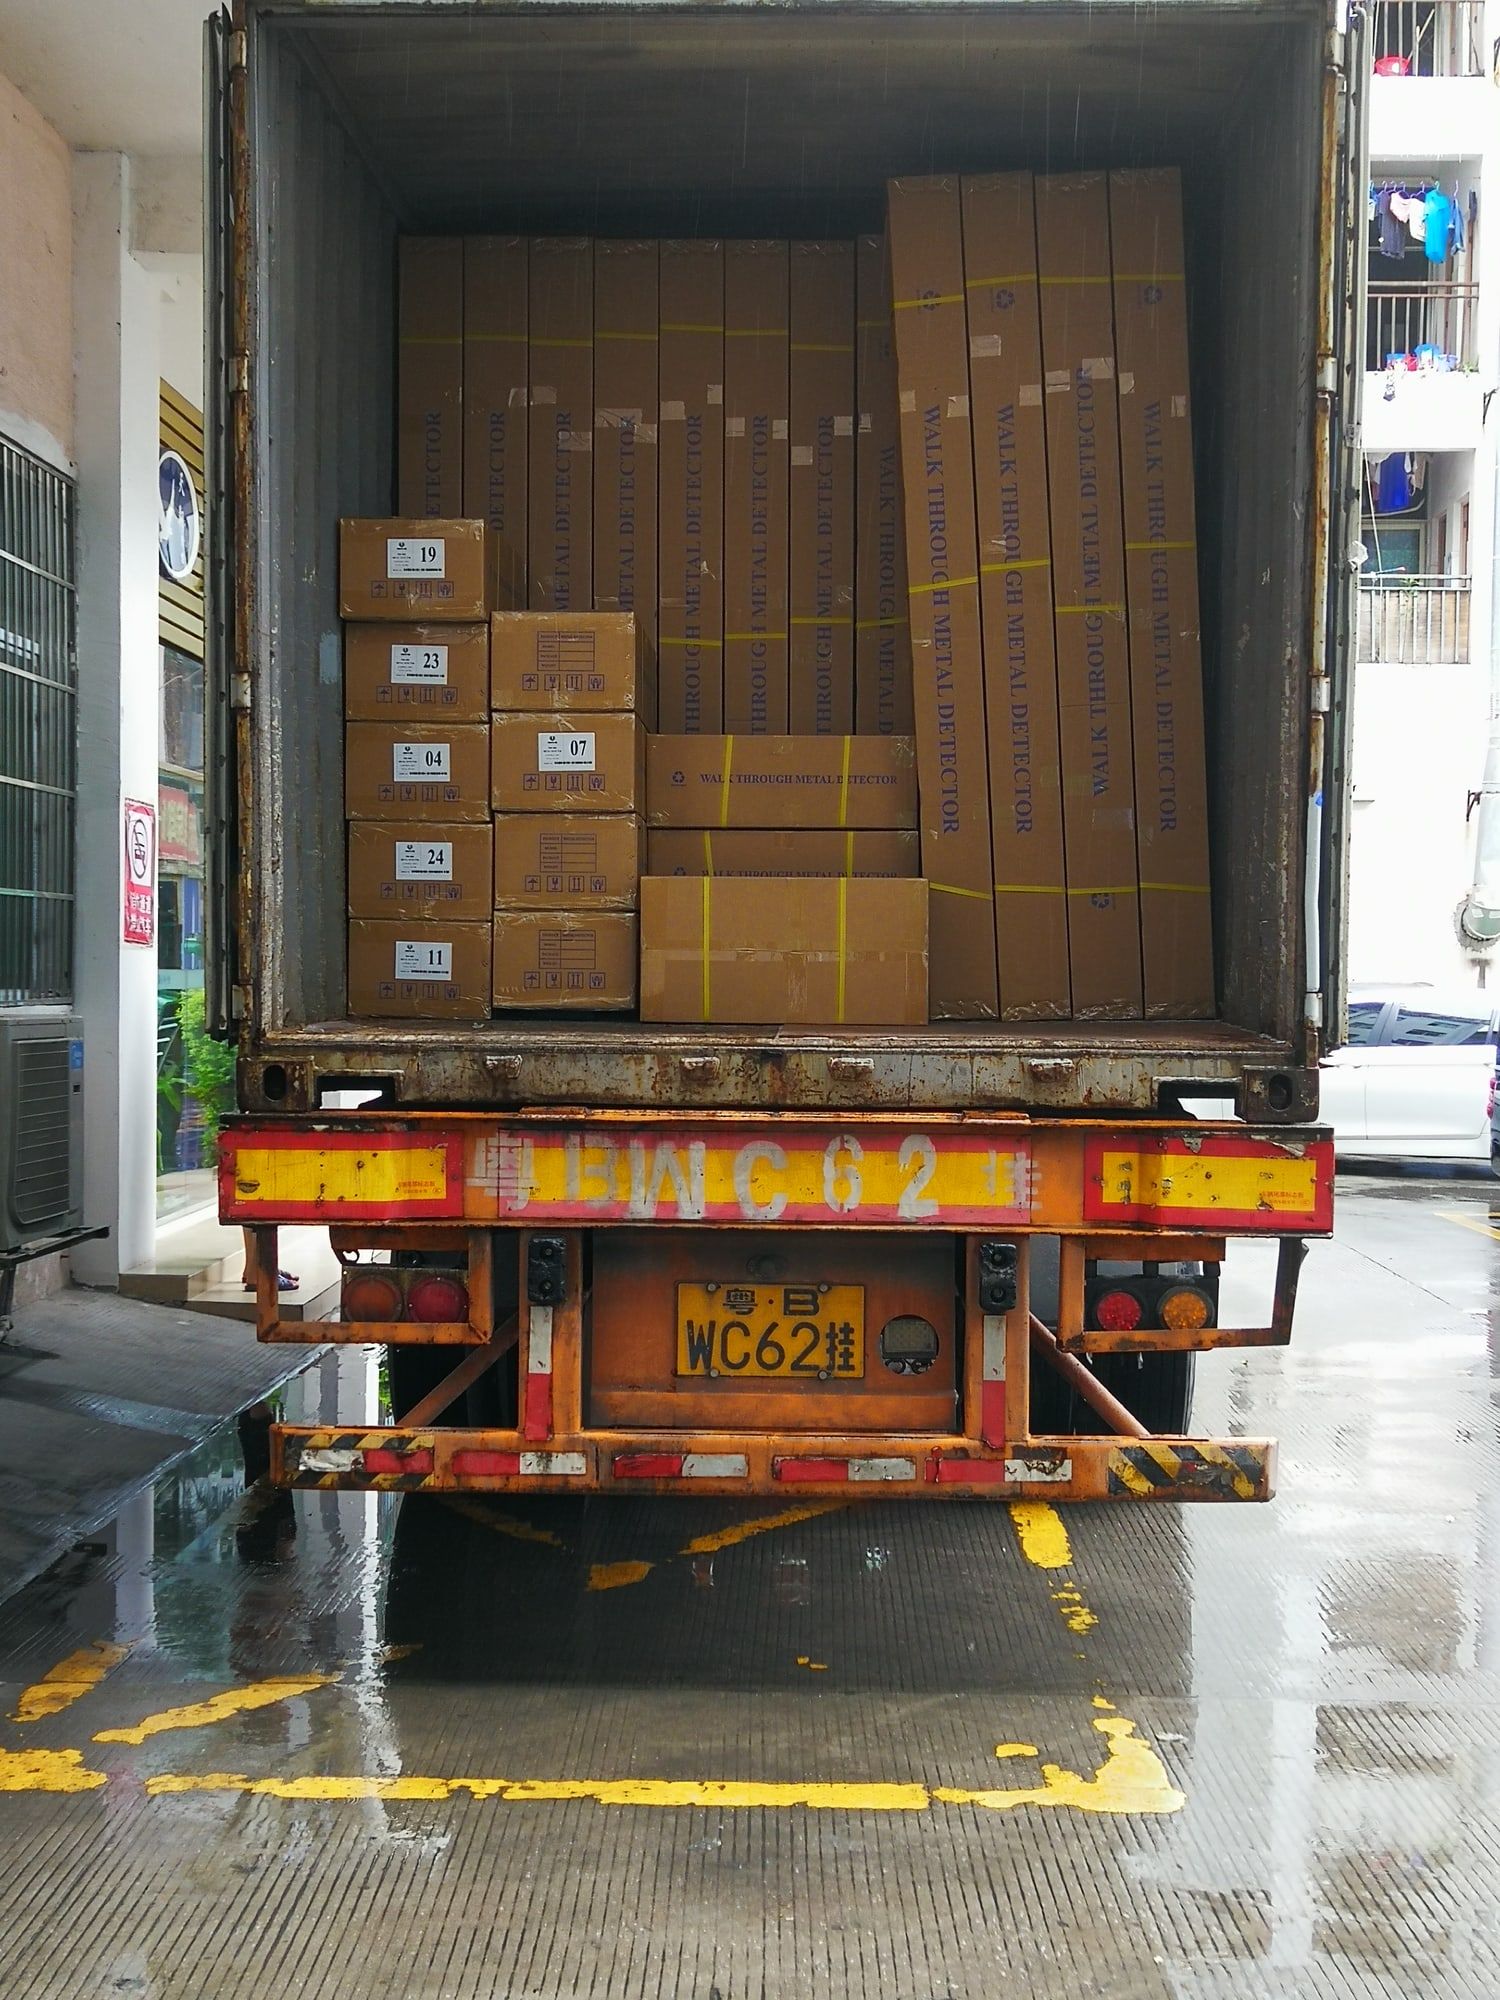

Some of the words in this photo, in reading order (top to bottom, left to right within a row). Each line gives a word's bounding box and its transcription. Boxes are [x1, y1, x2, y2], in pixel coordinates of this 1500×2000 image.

[426, 411, 441, 516] ETECTOR
[923, 404, 944, 478] WALK
[998, 404, 1017, 477] WALK
[1076, 367, 1098, 498] DETECTOR
[1143, 401, 1163, 473] WALK
[555, 411, 571, 533] DETECTOR
[619, 415, 635, 536] DETECTOR
[686, 414, 702, 536] DETECTOR
[752, 414, 769, 536] DETECTOR
[817, 415, 834, 536] DETECTOR
[879, 448, 896, 512] WALK
[420, 546, 437, 563] 19
[555, 536, 571, 611] METAL
[685, 541, 701, 617] METAL
[752, 541, 768, 617] METAL
[817, 541, 833, 618] METAL
[1001, 482, 1023, 606] THROUGH
[1081, 504, 1101, 590] METAL
[423, 652, 440, 669] 23
[816, 624, 833, 735] THROUGH
[878, 637, 895, 714] METAL
[933, 615, 955, 698] METAL
[1007, 614, 1028, 697] METAL
[1152, 613, 1172, 696] METAL
[425, 750, 442, 767] 04
[570, 740, 587, 756] 07
[736, 774, 792, 784] THROUGH
[795, 775, 834, 785] METAL
[937, 703, 960, 835] DETECTOR
[1011, 703, 1033, 834] DETECTOR
[1091, 726, 1111, 798] WALK
[1156, 702, 1177, 833] DETECTOR
[427, 848, 444, 865] 24
[428, 949, 443, 966] 11
[686, 1319, 856, 1372] WC62挂
